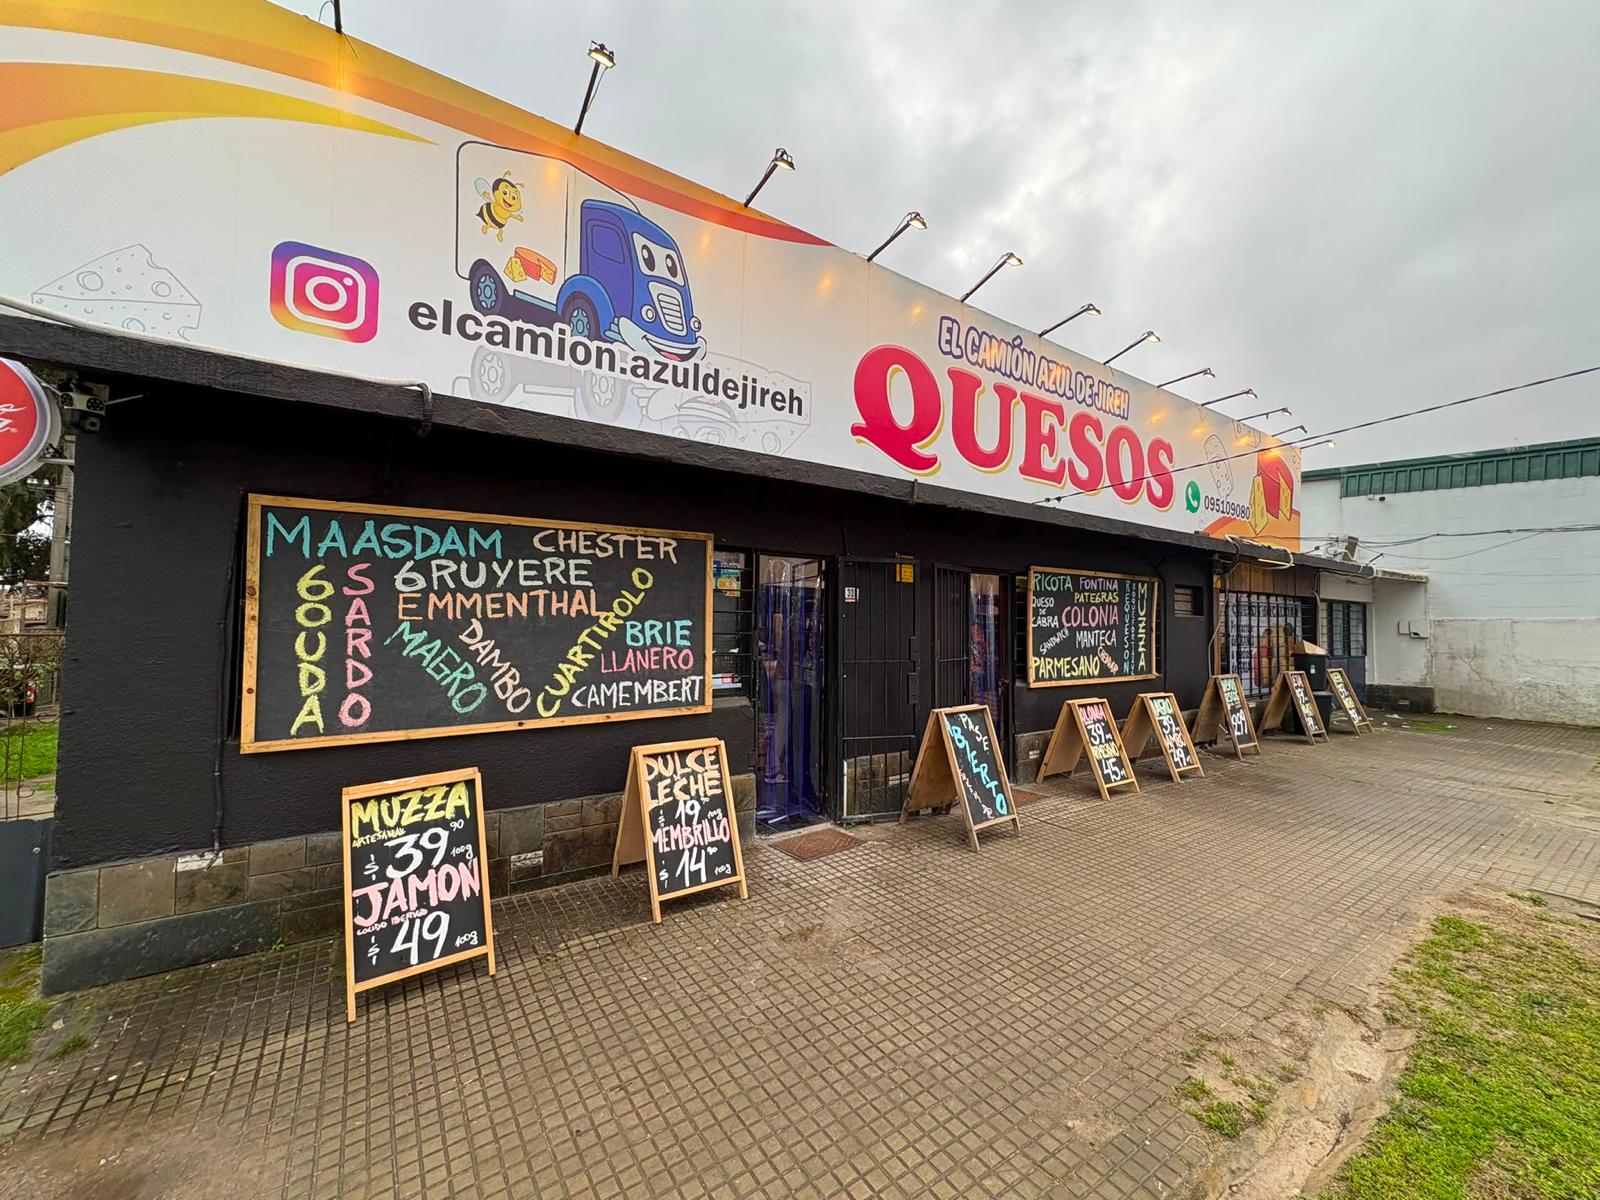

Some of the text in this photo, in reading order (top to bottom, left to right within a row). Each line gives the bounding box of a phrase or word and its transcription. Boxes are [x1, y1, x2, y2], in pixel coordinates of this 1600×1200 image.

[408, 299, 803, 416] elcamion.azuldejireh
[938, 316, 1130, 420] EL CAMIÓN AZUL DE JIREH
[850, 344, 1178, 513] QUESOS
[1204, 495, 1251, 521] 095109080
[266, 512, 502, 560] MAASDAM
[533, 530, 678, 564] CHESTER
[1033, 573, 1073, 592] RICOTA
[1074, 592, 1119, 604] PATEGRAS
[1080, 576, 1119, 591] FONTINA
[398, 589, 608, 620] EMMENTHAL
[1062, 605, 1119, 627] COLONIA
[536, 567, 654, 718] CUARTIROLO
[625, 619, 693, 647] BRIE
[1076, 629, 1117, 649] MANTECA
[1137, 582, 1148, 671] MUZZA
[338, 563, 375, 727] SARDO
[601, 648, 694, 673] LLANERO
[384, 621, 488, 714] MAGRO
[459, 618, 532, 713] DAMBO
[1033, 655, 1100, 680] PARMESANO
[571, 675, 704, 708] CAMEMBERT
[643, 747, 720, 781] DULCE
[645, 770, 723, 811] LECHE
[351, 781, 471, 838] MUZZA
[675, 800, 701, 825] 19
[651, 817, 730, 853] MEMBRILLO
[675, 847, 706, 887] 14
[352, 857, 480, 927] JAMON
[390, 911, 450, 965] 49
